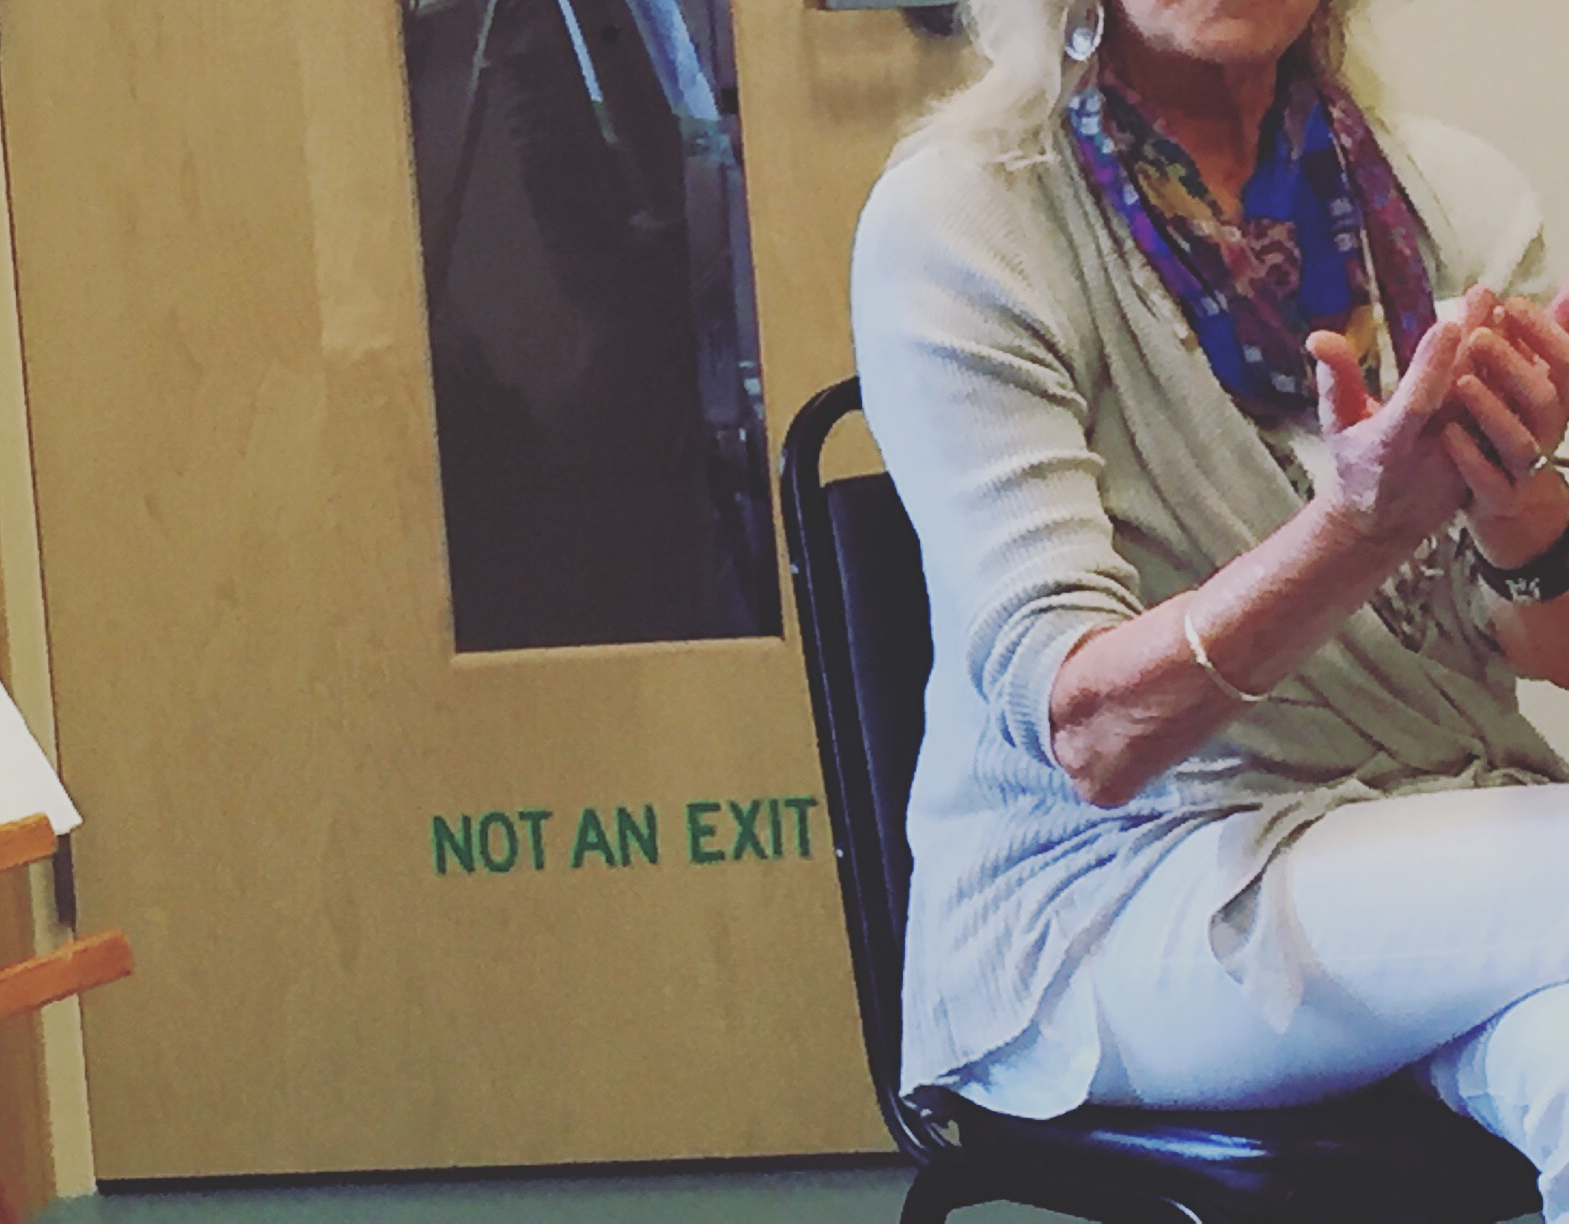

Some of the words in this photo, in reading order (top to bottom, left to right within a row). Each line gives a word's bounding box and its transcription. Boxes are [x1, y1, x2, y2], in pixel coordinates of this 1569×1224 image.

[432, 810, 553, 875] NOT
[570, 803, 660, 870] AN
[686, 797, 819, 865] EXIT
